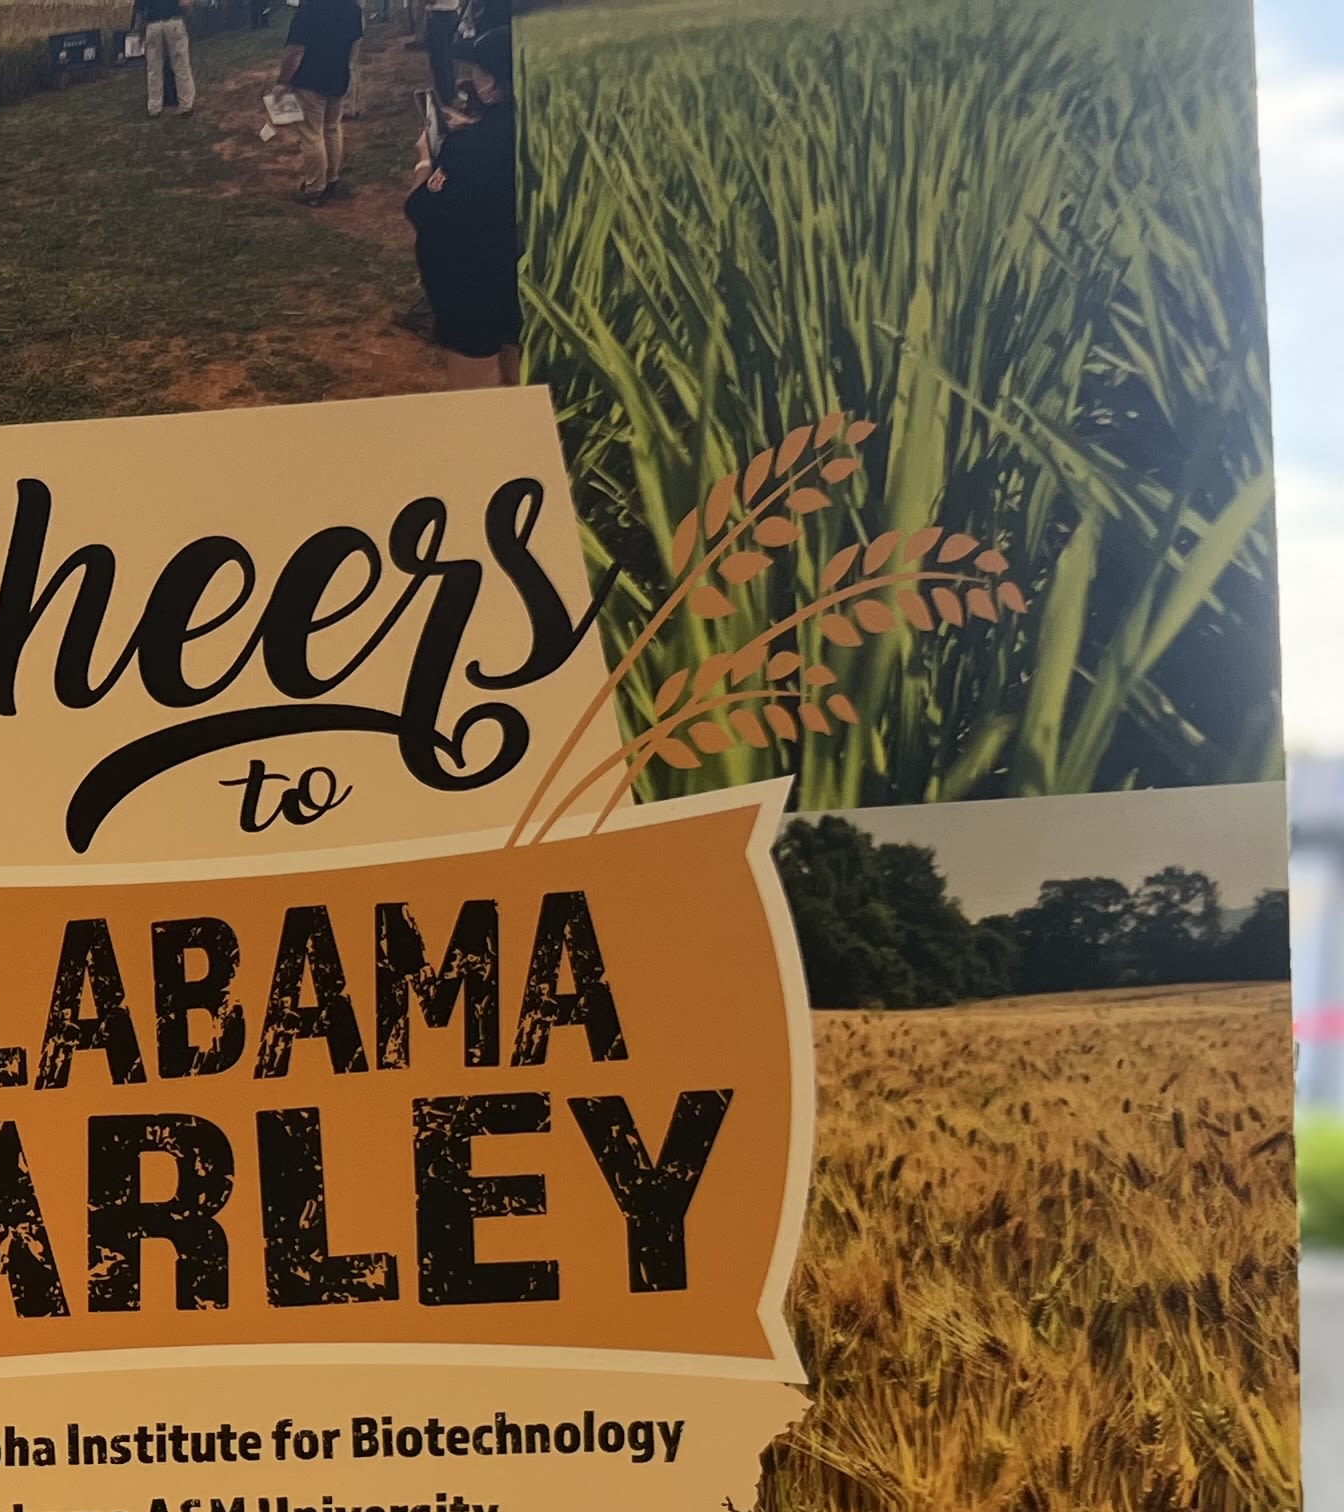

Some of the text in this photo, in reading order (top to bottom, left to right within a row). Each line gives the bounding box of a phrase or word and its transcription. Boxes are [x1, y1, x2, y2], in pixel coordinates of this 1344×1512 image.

[218, 756, 353, 834] to
[66, 1421, 263, 1467] Institute
[270, 1417, 342, 1462] for
[350, 1409, 686, 1464] Biotechnology
